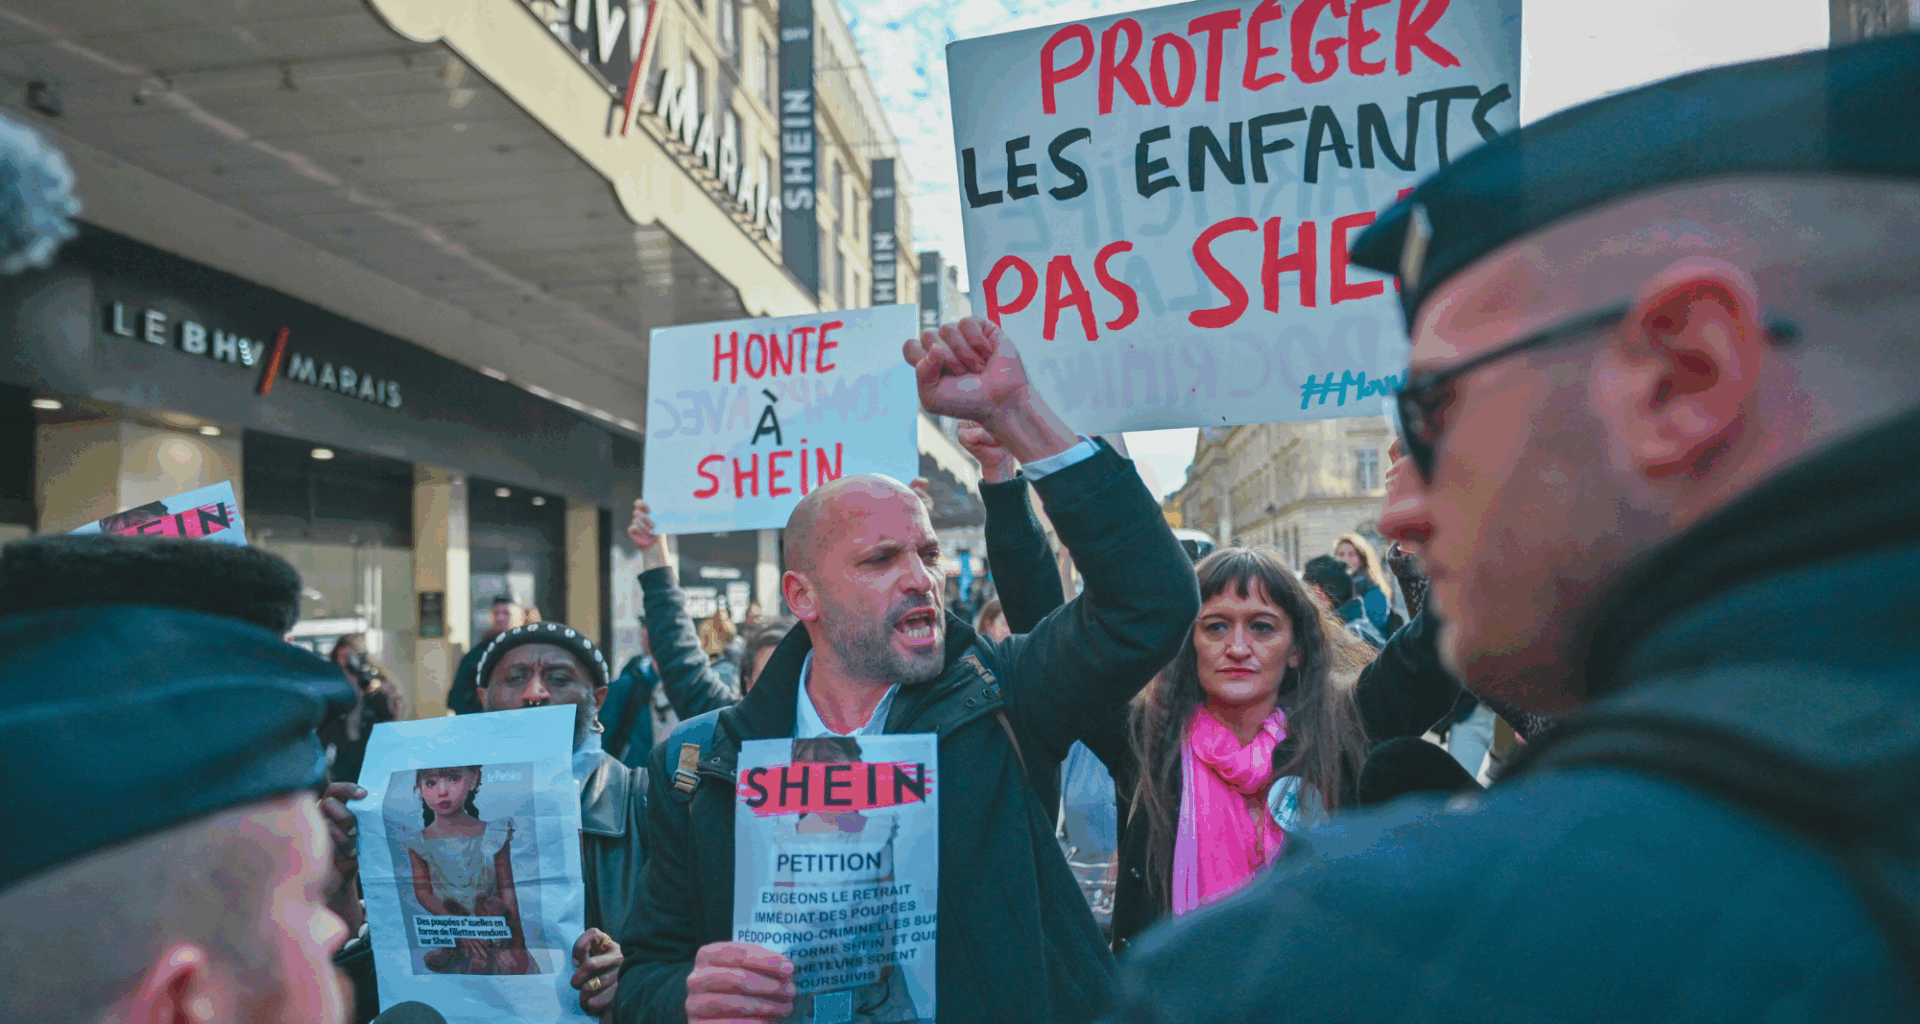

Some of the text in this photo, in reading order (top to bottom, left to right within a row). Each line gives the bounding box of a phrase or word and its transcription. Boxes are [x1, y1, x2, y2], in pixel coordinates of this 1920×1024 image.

[656, 60, 782, 244] MARAIS
[782, 89, 813, 210] SHEIN
[962, 128, 1091, 208] LES
[872, 232, 896, 304] HEIN
[983, 187, 1414, 341] PAS SHE
[113, 300, 402, 409] LE BHV MARAIS
[713, 320, 843, 384] HONTE
[751, 388, 782, 446] À
[745, 762, 926, 808] SHEIN
[777, 852, 882, 873] PETITION
[755, 900, 916, 924] IMMÉDIAT DES POUPÉES
[762, 884, 911, 905] EXIGEONS LE RETRAIT
[416, 917, 431, 926] Des
[431, 917, 460, 927] poupées
[418, 927, 439, 936] forme
[891, 933, 906, 946] ET
[867, 948, 917, 966] SOIENT
